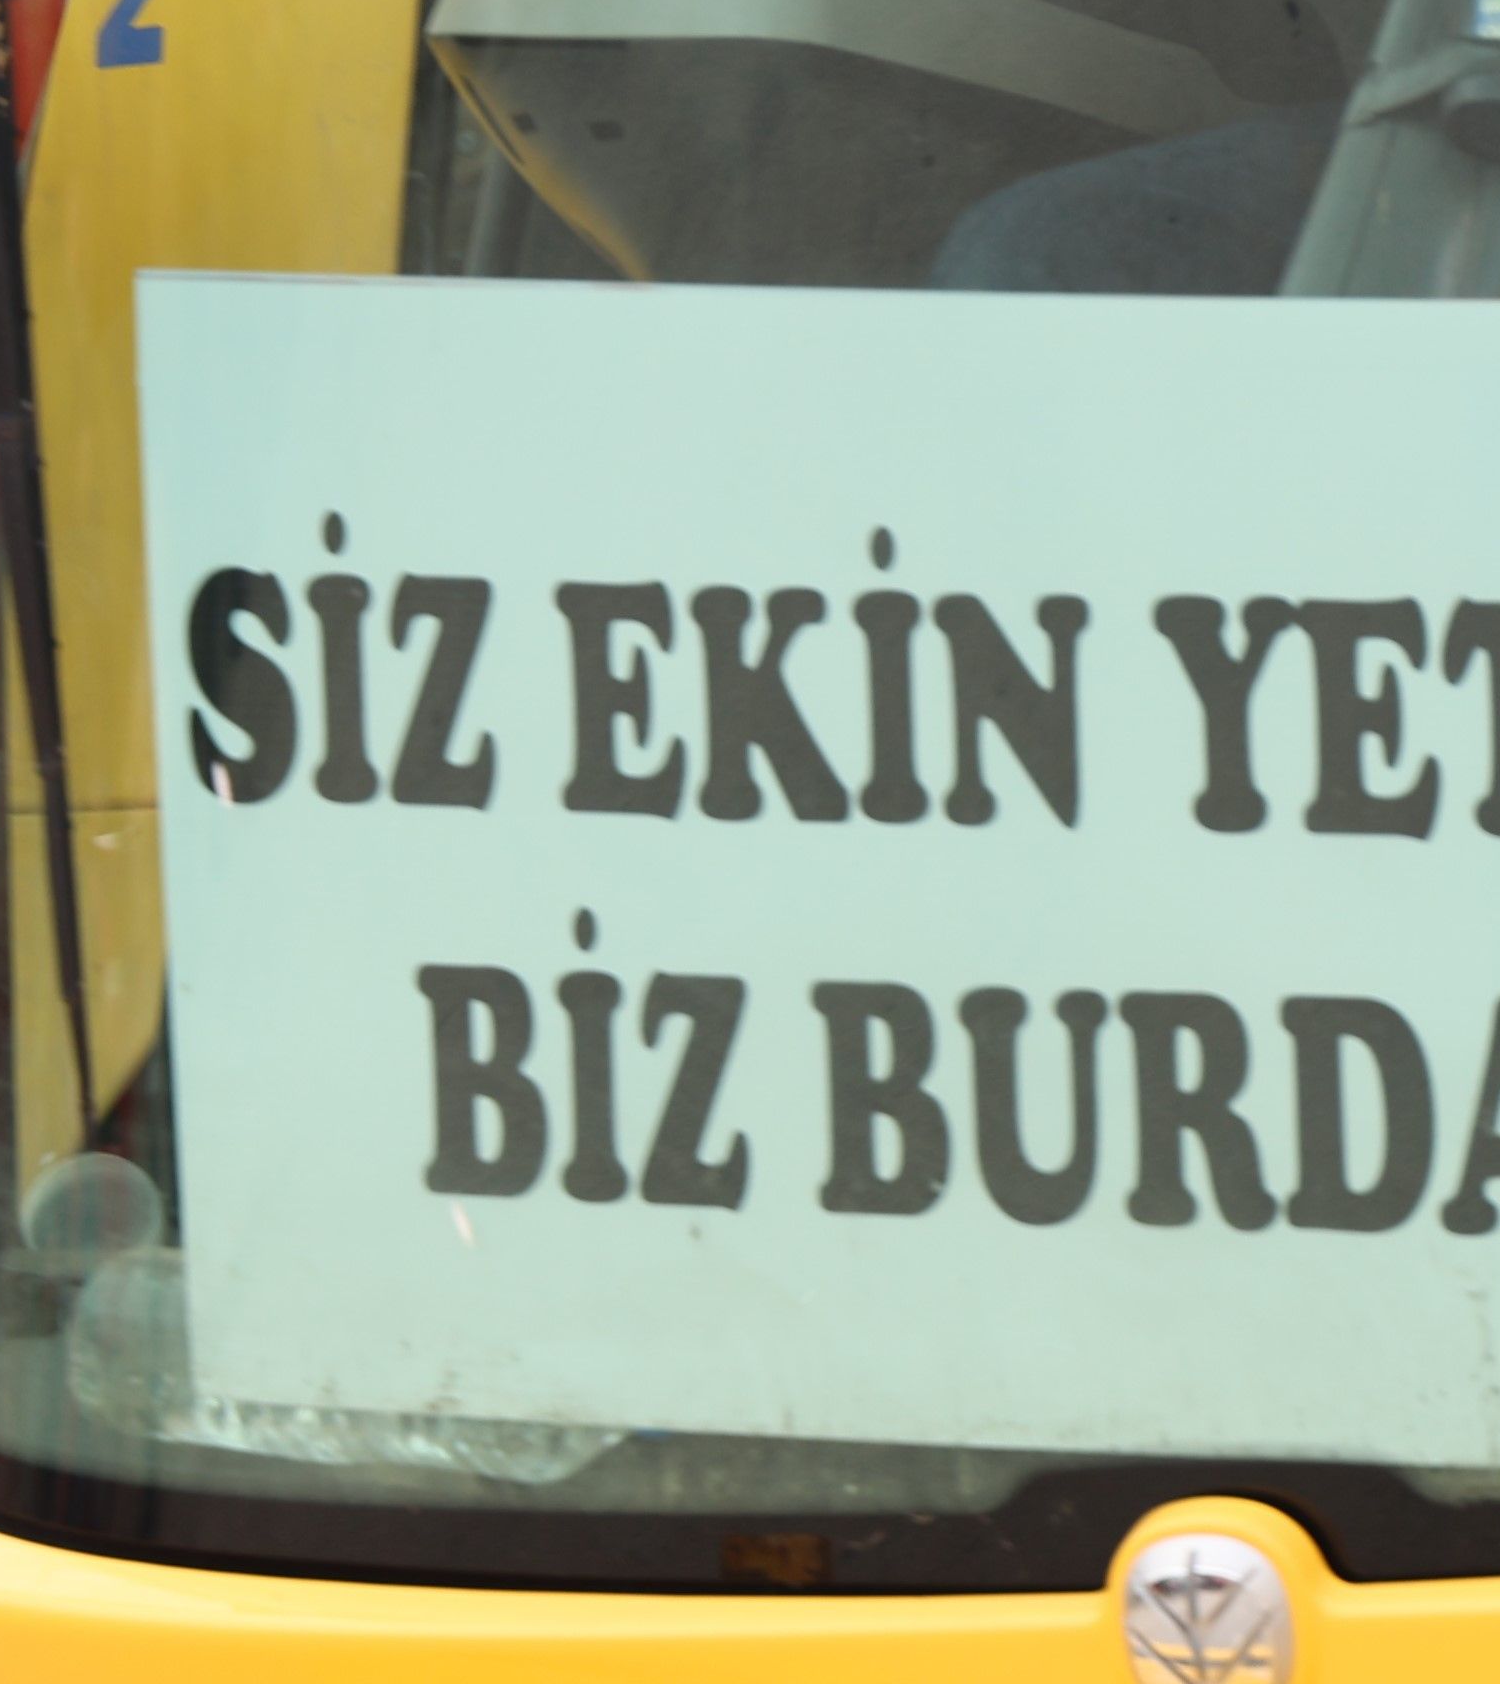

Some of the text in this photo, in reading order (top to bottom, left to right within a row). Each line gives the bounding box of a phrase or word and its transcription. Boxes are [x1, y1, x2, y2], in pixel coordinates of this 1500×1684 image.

[186, 510, 498, 812] SİZ
[554, 526, 1092, 830] EKİN
[416, 906, 752, 1214] BİZ
